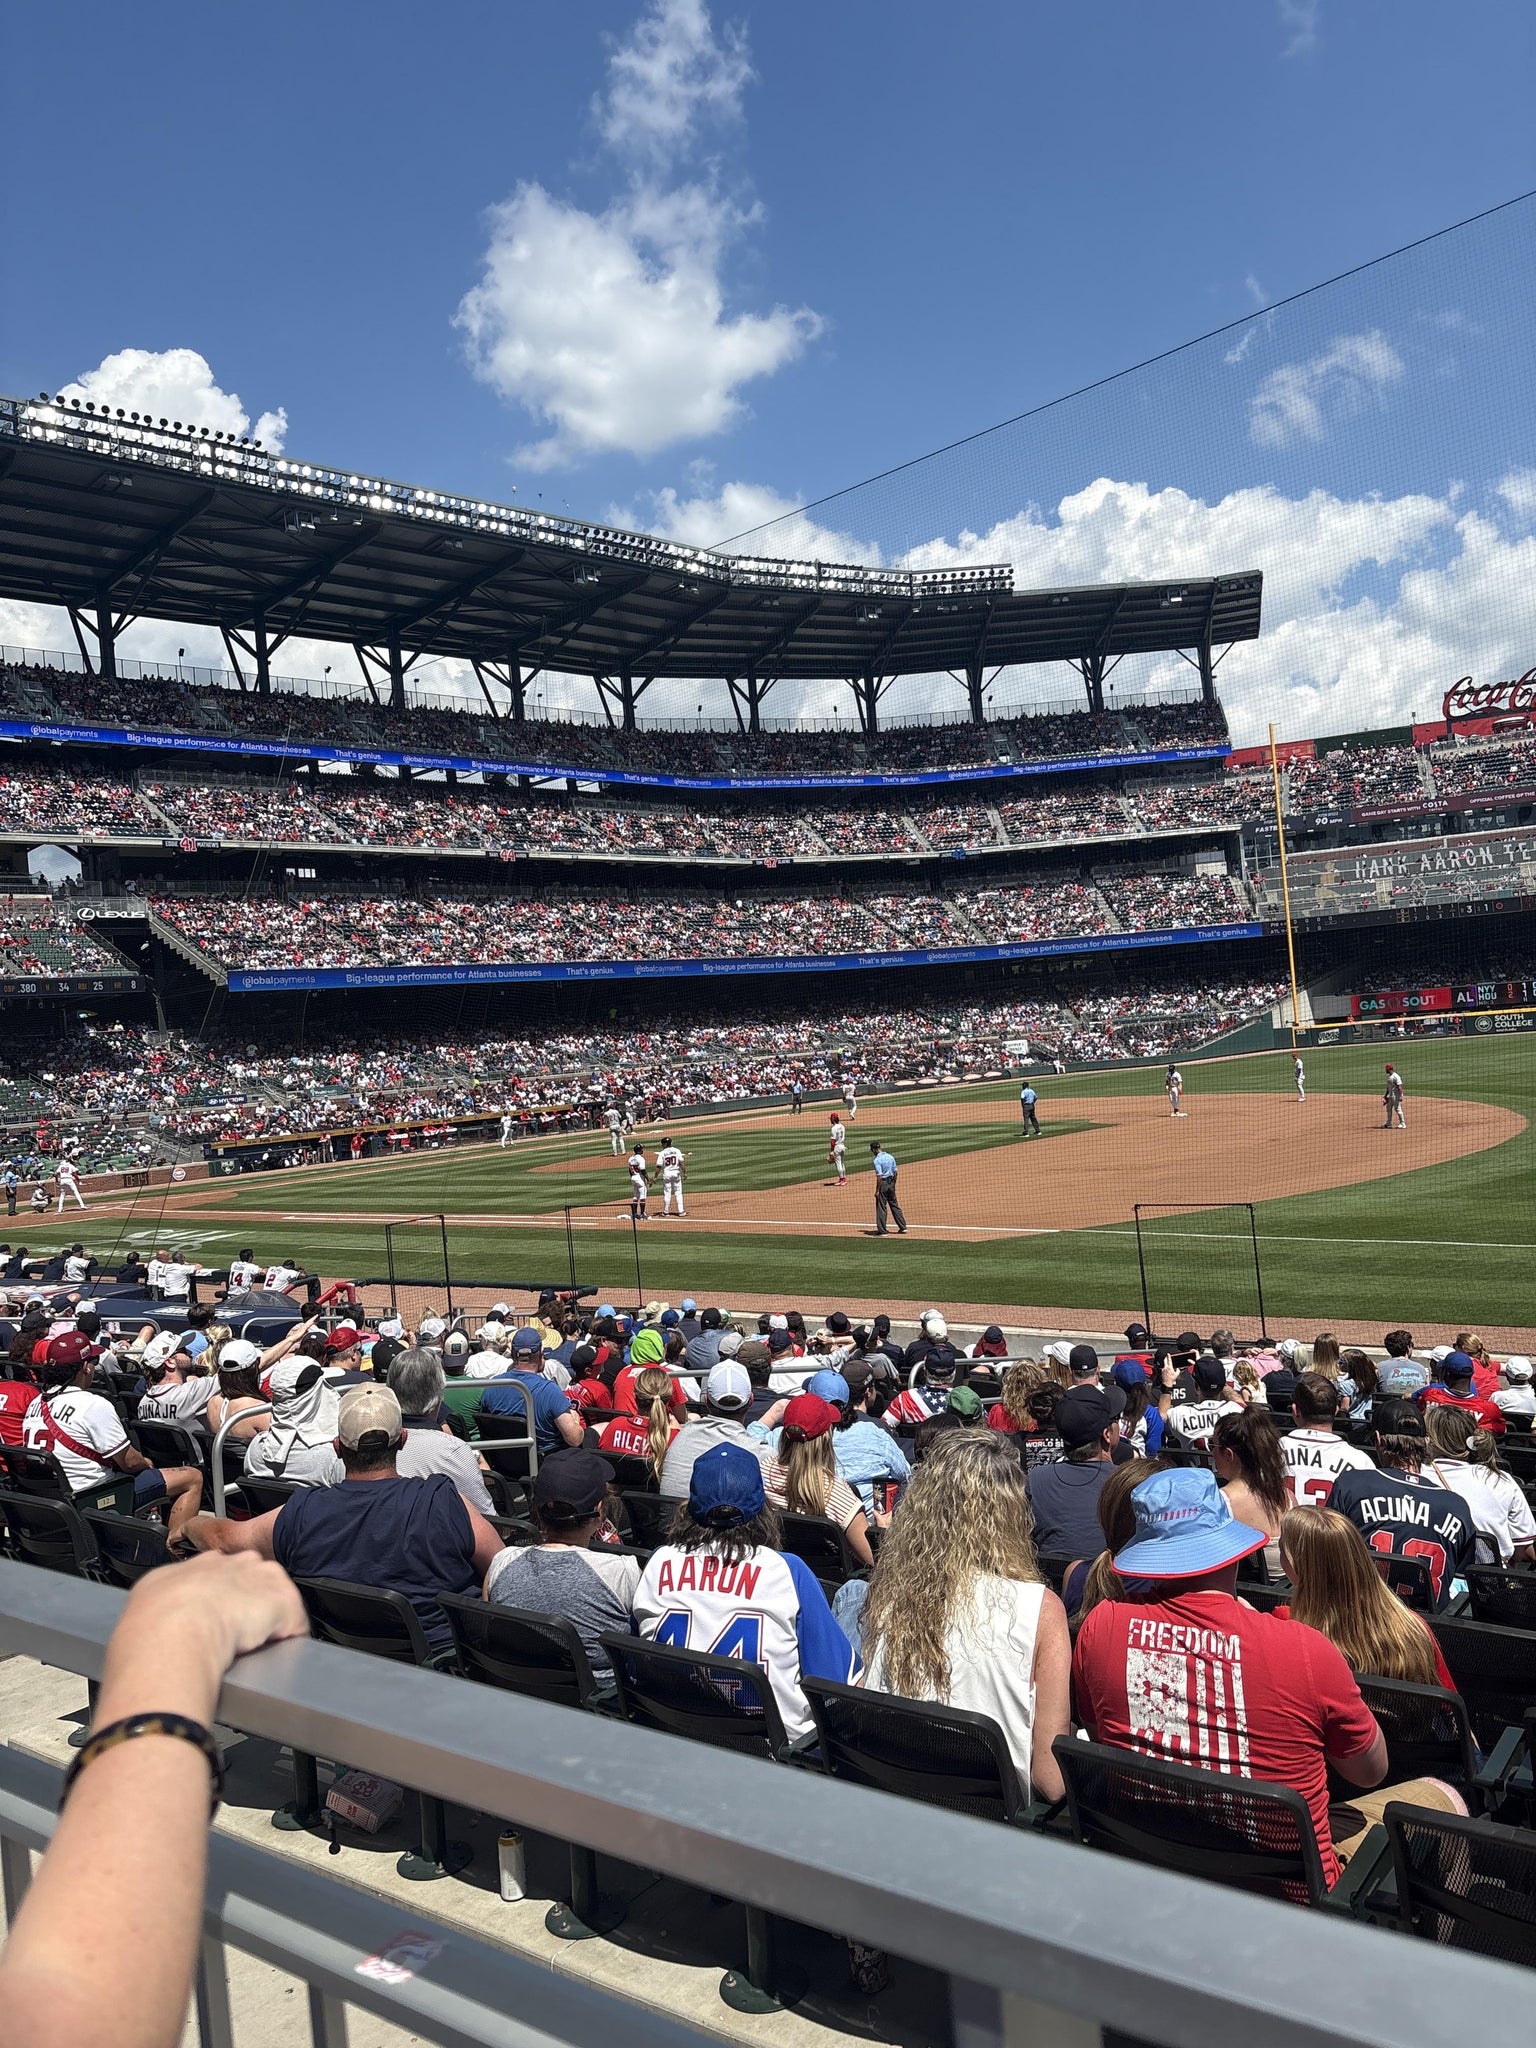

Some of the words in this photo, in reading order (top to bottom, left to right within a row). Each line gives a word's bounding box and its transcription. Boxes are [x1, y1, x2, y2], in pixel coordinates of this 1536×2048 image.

[127, 733, 172, 745] Big-league
[174, 737, 226, 748] performance
[227, 741, 239, 749] for
[240, 742, 268, 751] Atlanta
[269, 744, 311, 755] businesses
[335, 749, 357, 758] That's
[358, 752, 383, 760] genius.
[472, 761, 505, 770] Big-league
[506, 764, 544, 773] performance
[554, 768, 575, 776] Atlanta
[576, 769, 606, 778] businesses
[624, 773, 640, 781] That's
[1422, 800, 1448, 809] COSTA
[1469, 796, 1494, 804] OFFICIAL
[1494, 793, 1516, 801] COFFEE
[1315, 817, 1328, 826] 90
[1329, 817, 1343, 825] MPH
[1255, 824, 1291, 833] FASTBLL
[180, 837, 198, 852] 41
[500, 848, 516, 862] 44
[1355, 855, 1408, 879] HANK
[1420, 847, 1493, 872] AARON
[1504, 839, 1536, 865] TE
[96, 910, 145, 918] LEXUS
[1466, 905, 1473, 914] 3
[1484, 904, 1489, 912] 1
[1197, 930, 1221, 939] That's
[998, 946, 1038, 956] Big-league
[1039, 941, 1089, 953] performance
[1089, 939, 1100, 948] for
[1102, 938, 1129, 947] Atlanta
[1130, 934, 1173, 946] businesses
[703, 963, 736, 973] Big-league
[737, 962, 774, 972] performance
[775, 961, 784, 969] for
[805, 960, 836, 968] businesses
[858, 957, 880, 965] That's
[346, 973, 395, 984] Big-league
[397, 971, 451, 983] performance
[454, 970, 467, 979] for
[468, 970, 497, 979] Atlanta
[498, 968, 542, 978] businesses
[566, 967, 588, 976] That's
[590, 967, 615, 976] genius.
[18, 983, 37, 993] .380
[58, 982, 70, 992] 34
[93, 981, 104, 991] 25
[130, 980, 137, 989] 8
[1477, 985, 1496, 994] NYY
[1457, 991, 1474, 1003] AL
[1478, 992, 1497, 1001] HOU
[1359, 999, 1386, 1010] GAS
[1494, 1013, 1524, 1022] SOUTH
[1494, 1019, 1534, 1028] COLLEGE
[664, 1155, 677, 1167] 30
[230, 1271, 244, 1287] 14
[265, 1273, 276, 1288] 2
[53, 1403, 76, 1425] JR.
[138, 1400, 161, 1420] CUÑA
[162, 1403, 180, 1420] JR.
[1359, 1494, 1430, 1528] ACUÑA
[1433, 1512, 1462, 1544] JR.
[658, 1555, 762, 1601] AARON
[1127, 1617, 1241, 1662] FREEDOM
